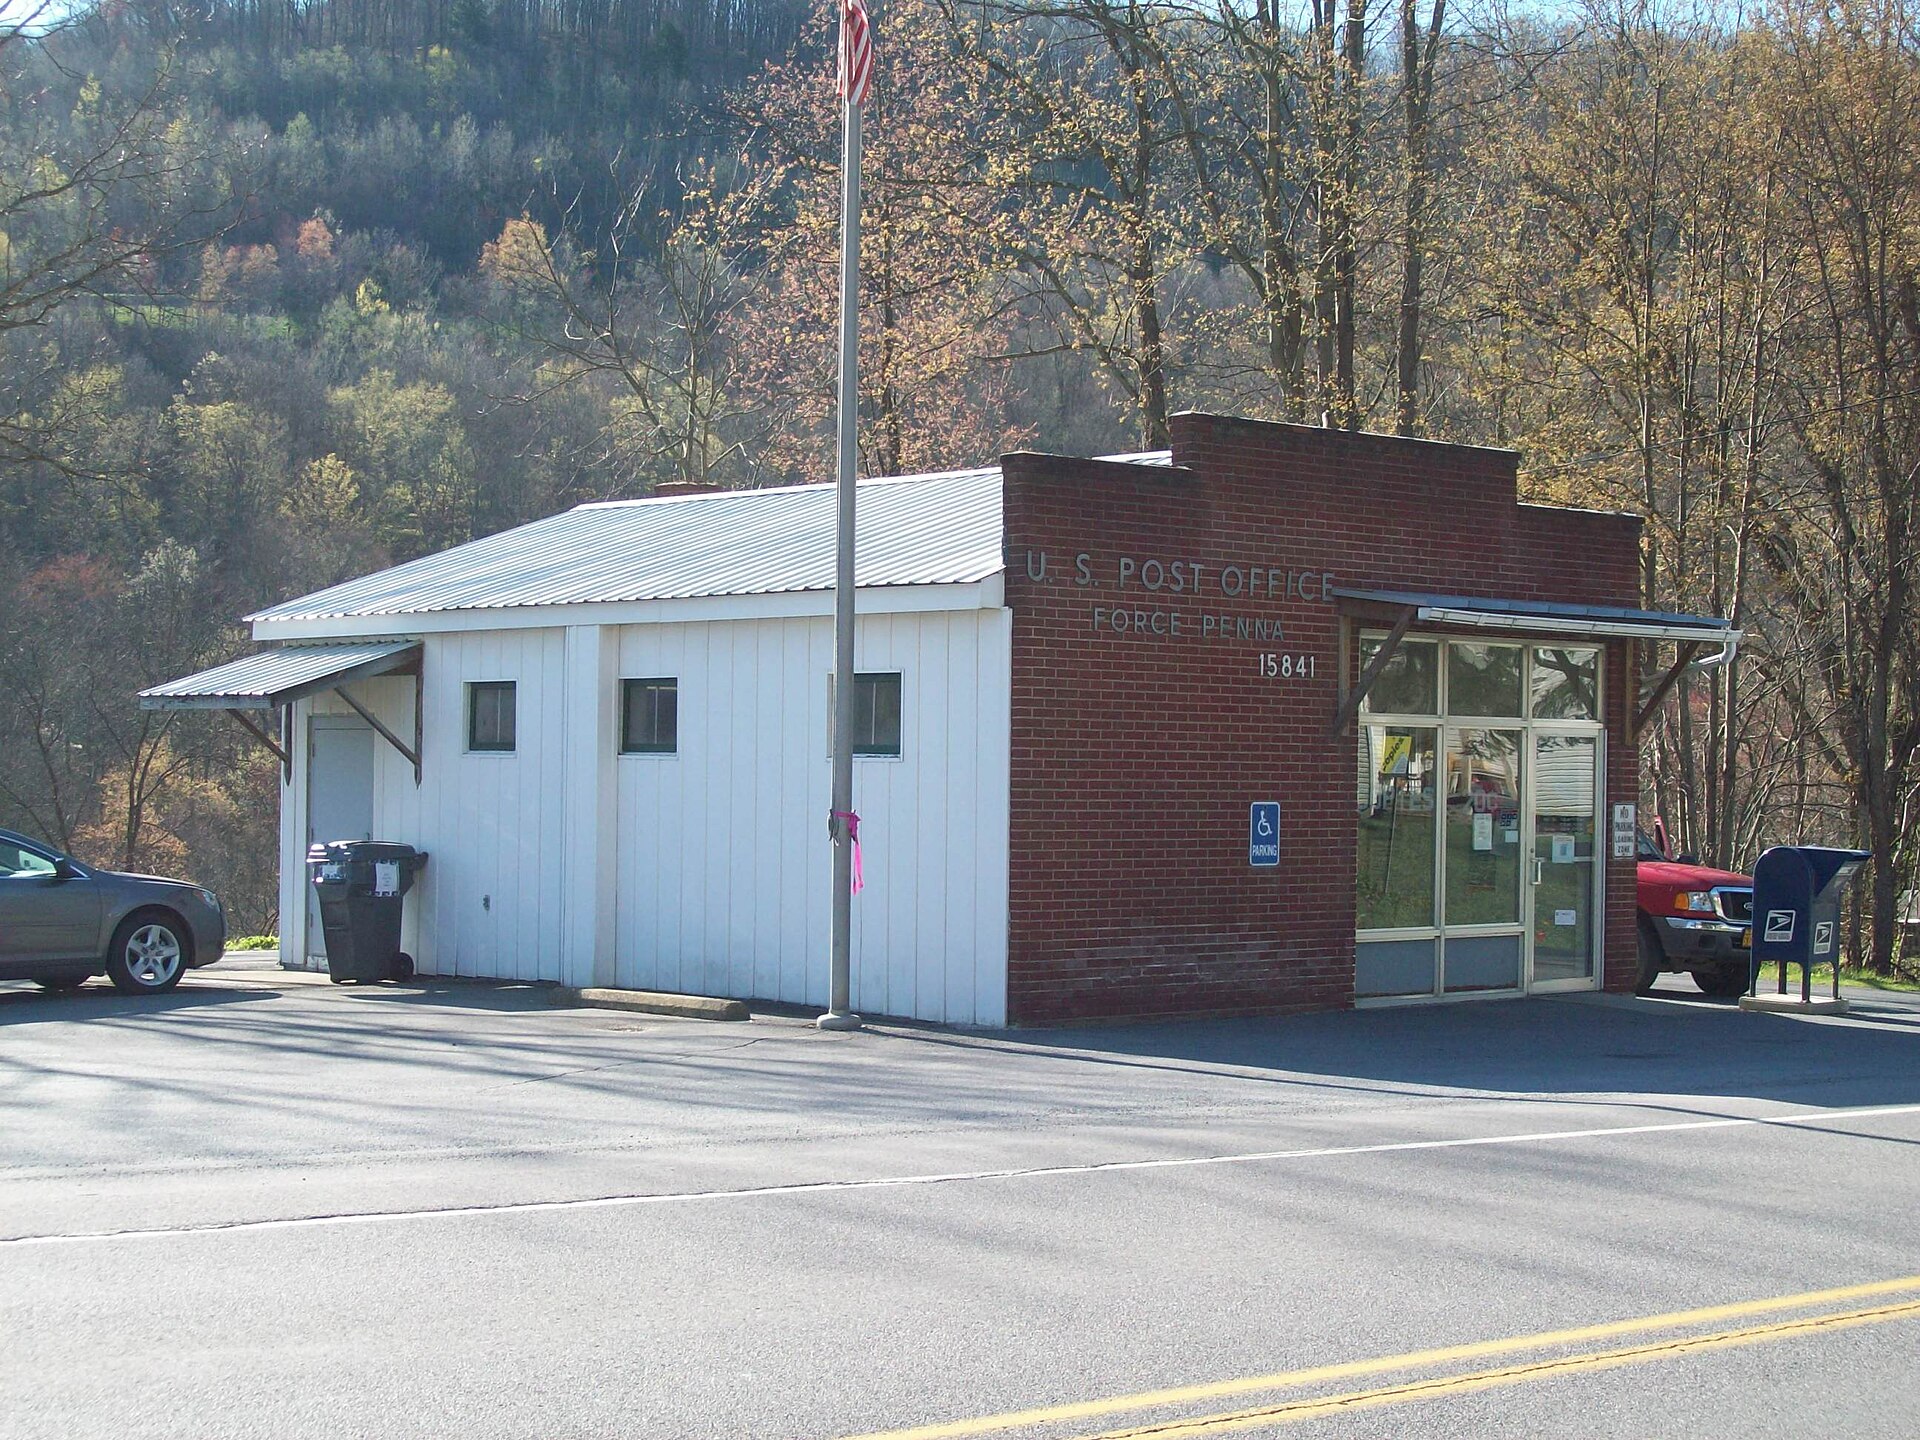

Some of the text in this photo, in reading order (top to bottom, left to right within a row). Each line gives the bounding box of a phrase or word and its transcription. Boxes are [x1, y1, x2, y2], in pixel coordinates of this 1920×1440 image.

[1027, 550, 1336, 601] U. S. POST OFFICE
[1093, 607, 1284, 641] FORCE PENNA
[1259, 653, 1315, 678] 15841
[1620, 808, 1629, 819] NO
[1252, 844, 1277, 857] PARKING
